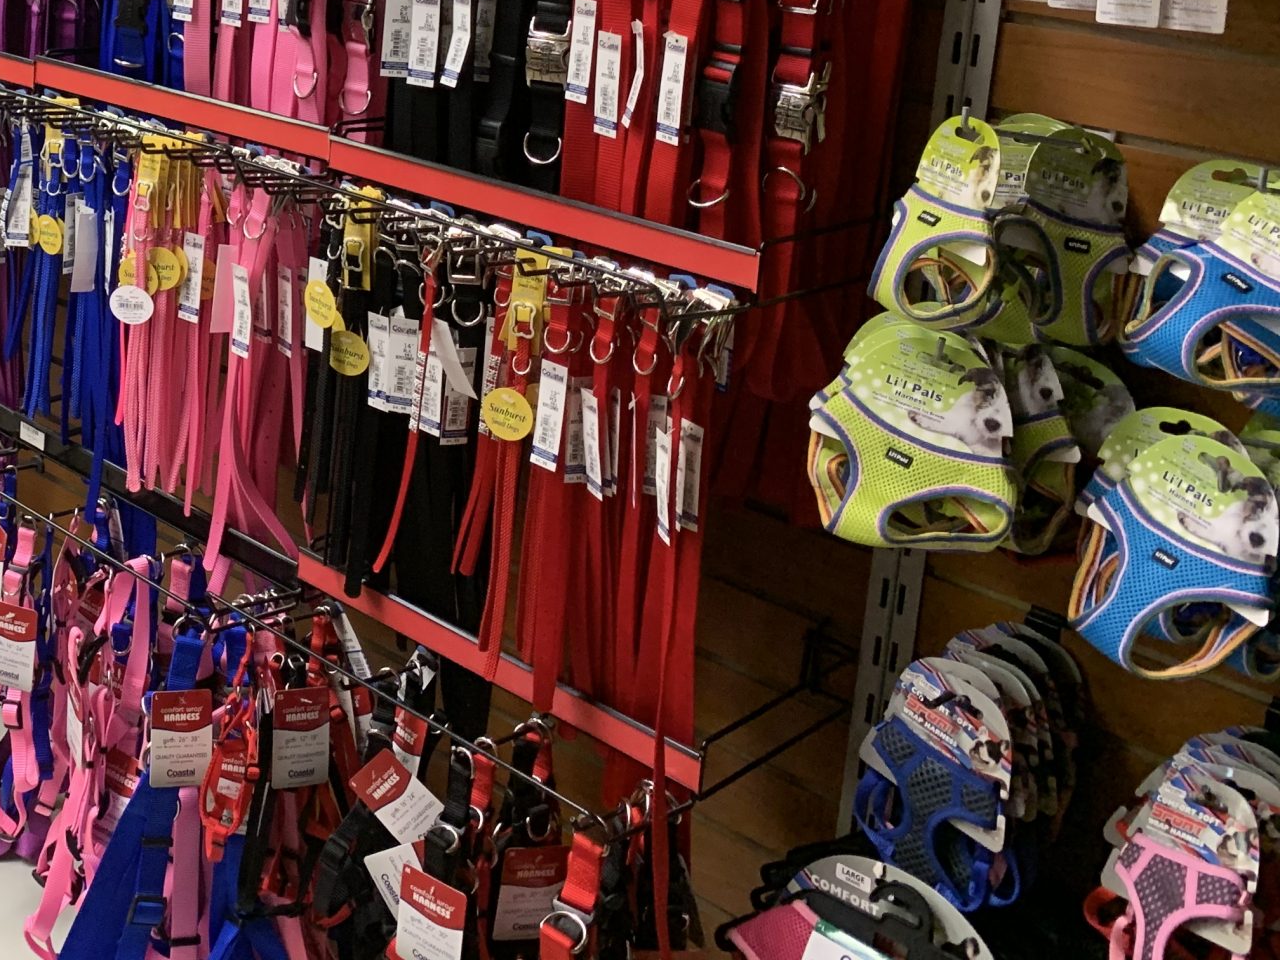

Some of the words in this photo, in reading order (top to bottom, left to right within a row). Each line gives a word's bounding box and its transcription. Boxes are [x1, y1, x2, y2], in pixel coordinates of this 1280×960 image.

[931, 157, 943, 169] Li'l
[945, 163, 963, 177] Pals
[1062, 175, 1085, 189] Pals
[1182, 201, 1200, 212] Li'l
[1248, 215, 1269, 230] Li'l
[886, 374, 907, 389] Li'l
[912, 383, 944, 402] Pals
[895, 390, 927, 406] Harness
[489, 402, 527, 423] Sunburst
[492, 419, 506, 429] Small
[506, 423, 520, 433] Dogs
[1163, 470, 1182, 489] Li'l
[1185, 484, 1213, 507] Pals
[1169, 488, 1197, 509] Harness
[163, 712, 200, 722] HARNESS
[185, 707, 203, 715] wrap
[285, 711, 319, 722] HARNESS
[903, 707, 924, 723] WRAP
[924, 721, 957, 747] HARNESS
[166, 769, 196, 778] Coastal
[288, 768, 315, 779] Coastal
[372, 773, 400, 800] HARNESS
[1157, 795, 1197, 816] COMFORT
[1198, 810, 1220, 826] SOFT
[1148, 817, 1169, 830] WRAP
[1170, 828, 1205, 847] HARNESS
[841, 868, 865, 884] LARGE
[410, 884, 435, 902] comfort
[436, 899, 456, 912] wrap
[811, 874, 880, 916] COMFORT
[413, 893, 451, 919] HARNESS
